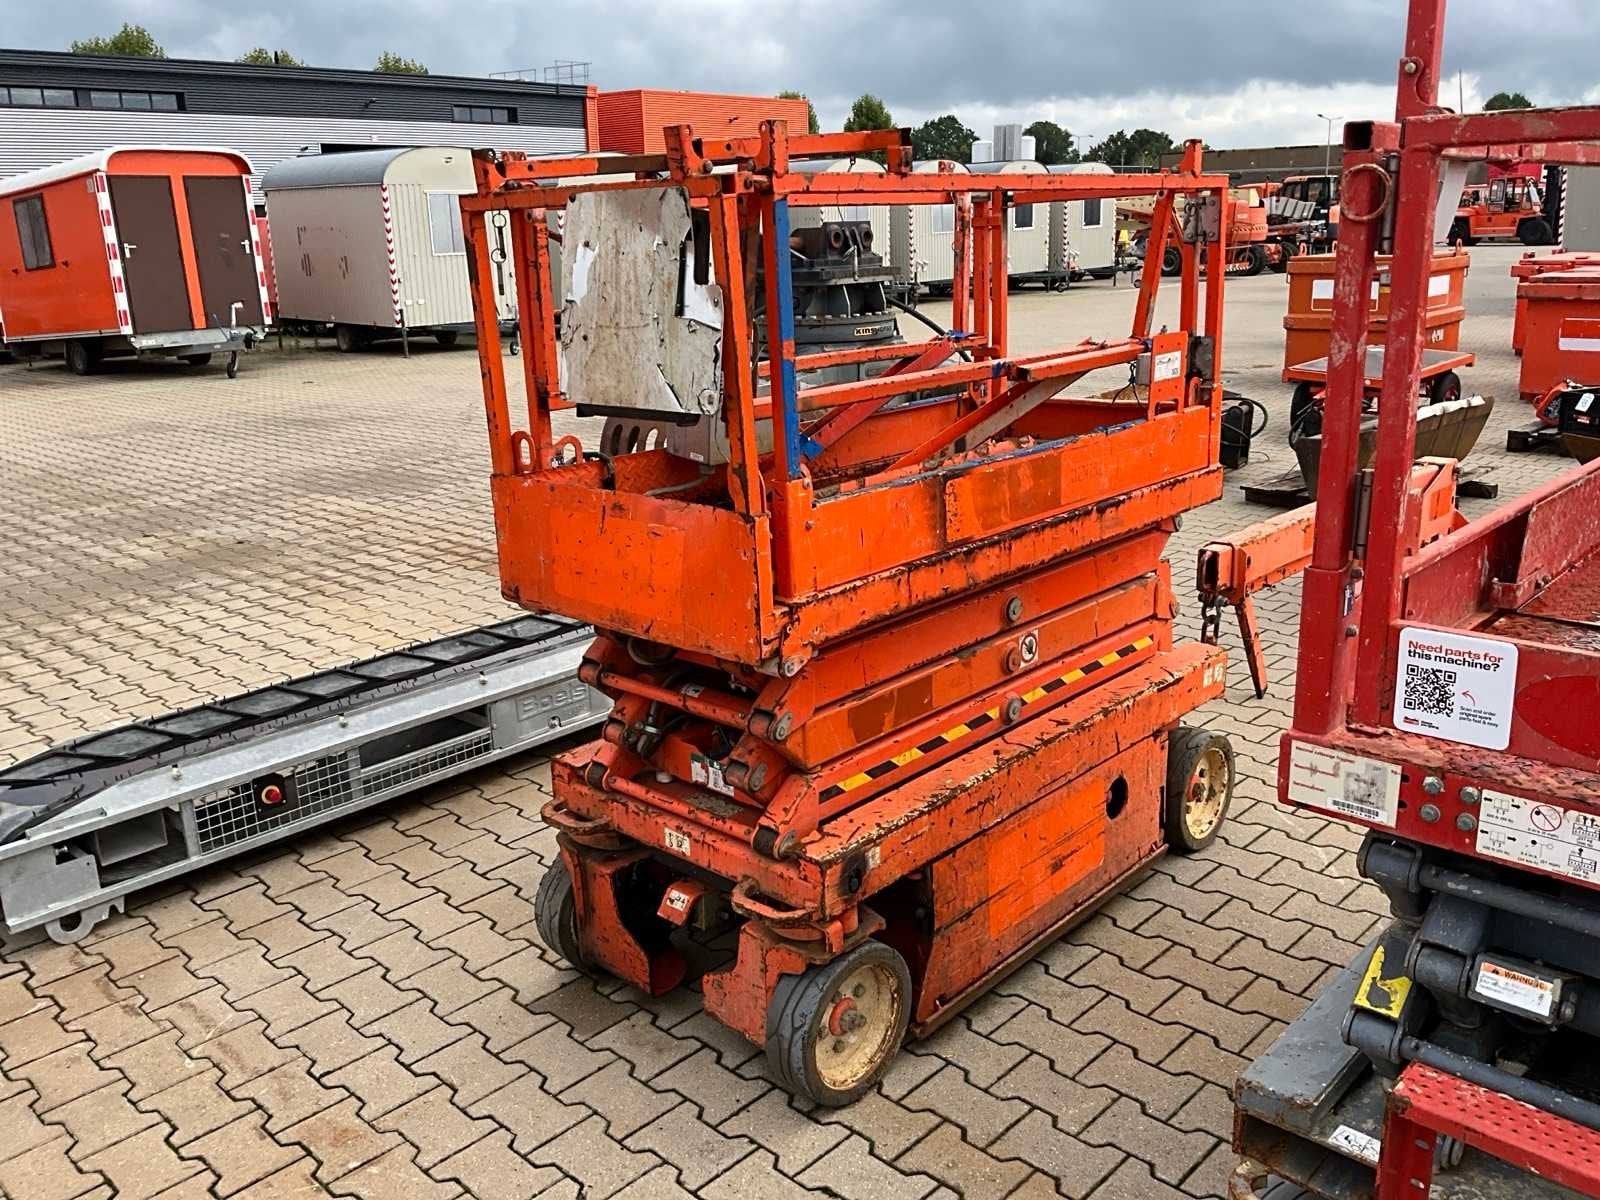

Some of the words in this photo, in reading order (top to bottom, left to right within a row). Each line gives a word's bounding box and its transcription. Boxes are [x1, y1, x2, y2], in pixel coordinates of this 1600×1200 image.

[1408, 640, 1443, 654] Need
[1445, 647, 1481, 660] parts
[1483, 652, 1504, 663] for
[1408, 648, 1433, 661] this
[1434, 654, 1500, 672] machine?
